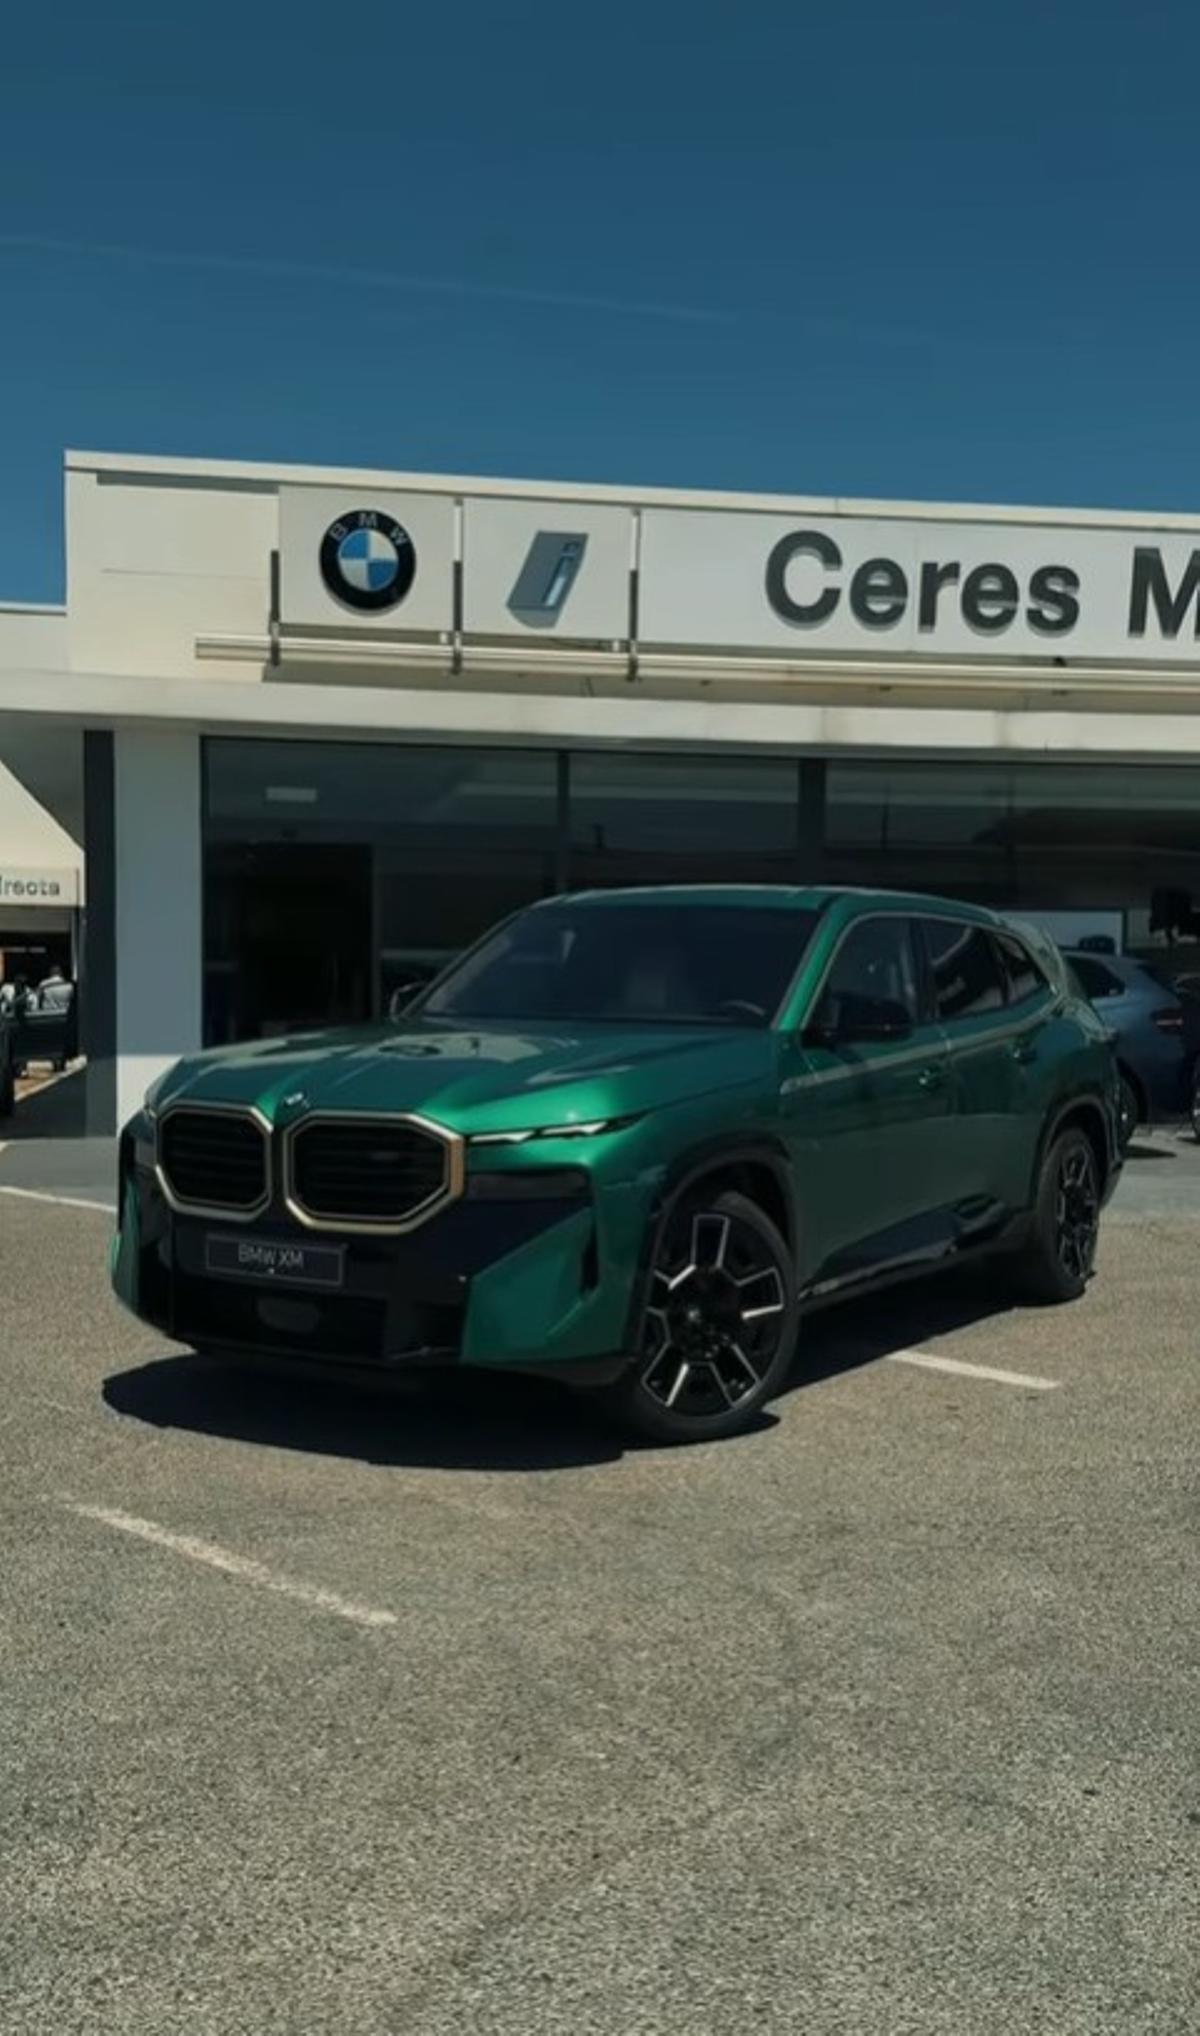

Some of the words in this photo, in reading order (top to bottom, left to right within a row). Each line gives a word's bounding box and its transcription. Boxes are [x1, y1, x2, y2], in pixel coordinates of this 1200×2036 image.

[329, 512, 408, 545] BMW
[765, 530, 1080, 637] Ceres
[238, 1243, 275, 1265] BMW
[279, 1248, 304, 1268] XM
